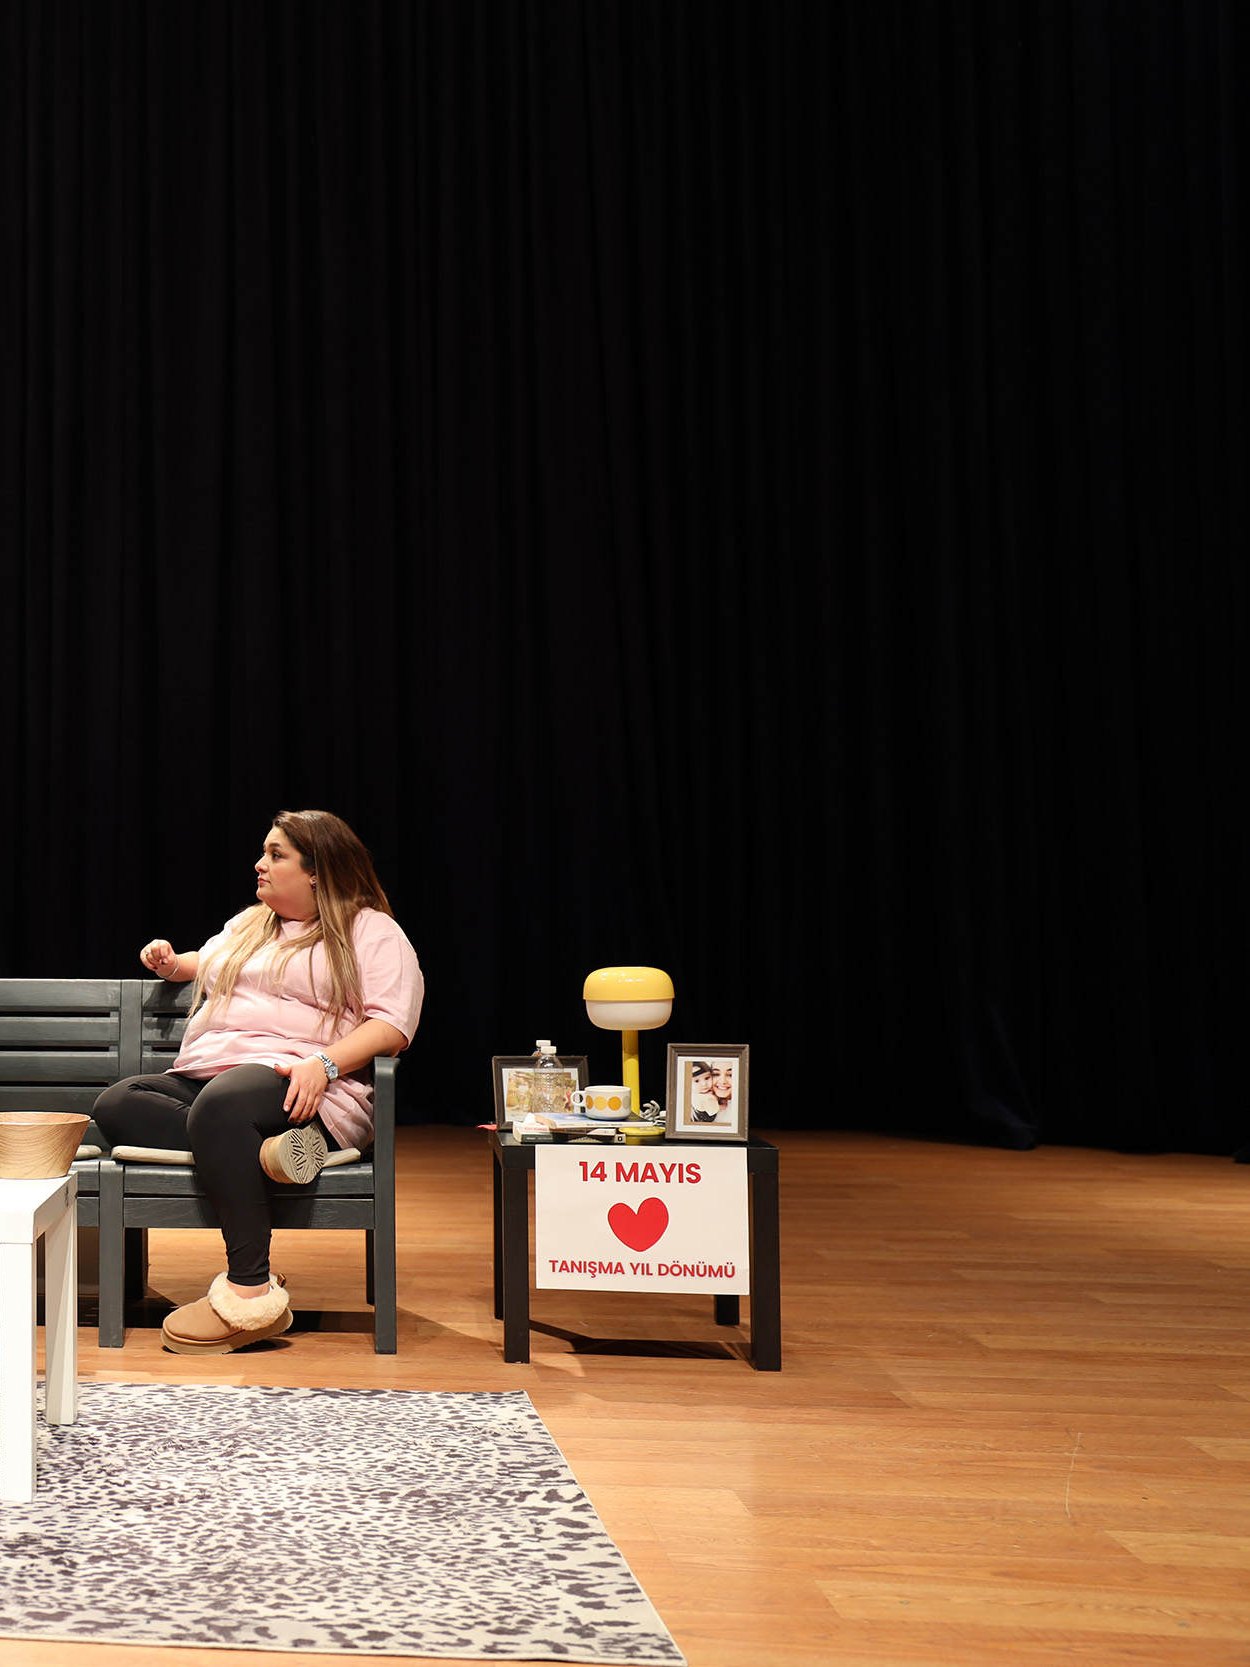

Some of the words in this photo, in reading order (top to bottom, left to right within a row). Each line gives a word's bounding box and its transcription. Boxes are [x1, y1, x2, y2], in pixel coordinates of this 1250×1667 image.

[579, 1161, 607, 1182] 14
[616, 1162, 701, 1184] MAYIS
[549, 1260, 625, 1278] TANIŞMA
[630, 1262, 653, 1275] YIL
[658, 1261, 735, 1279] DÖNÜMÜ
